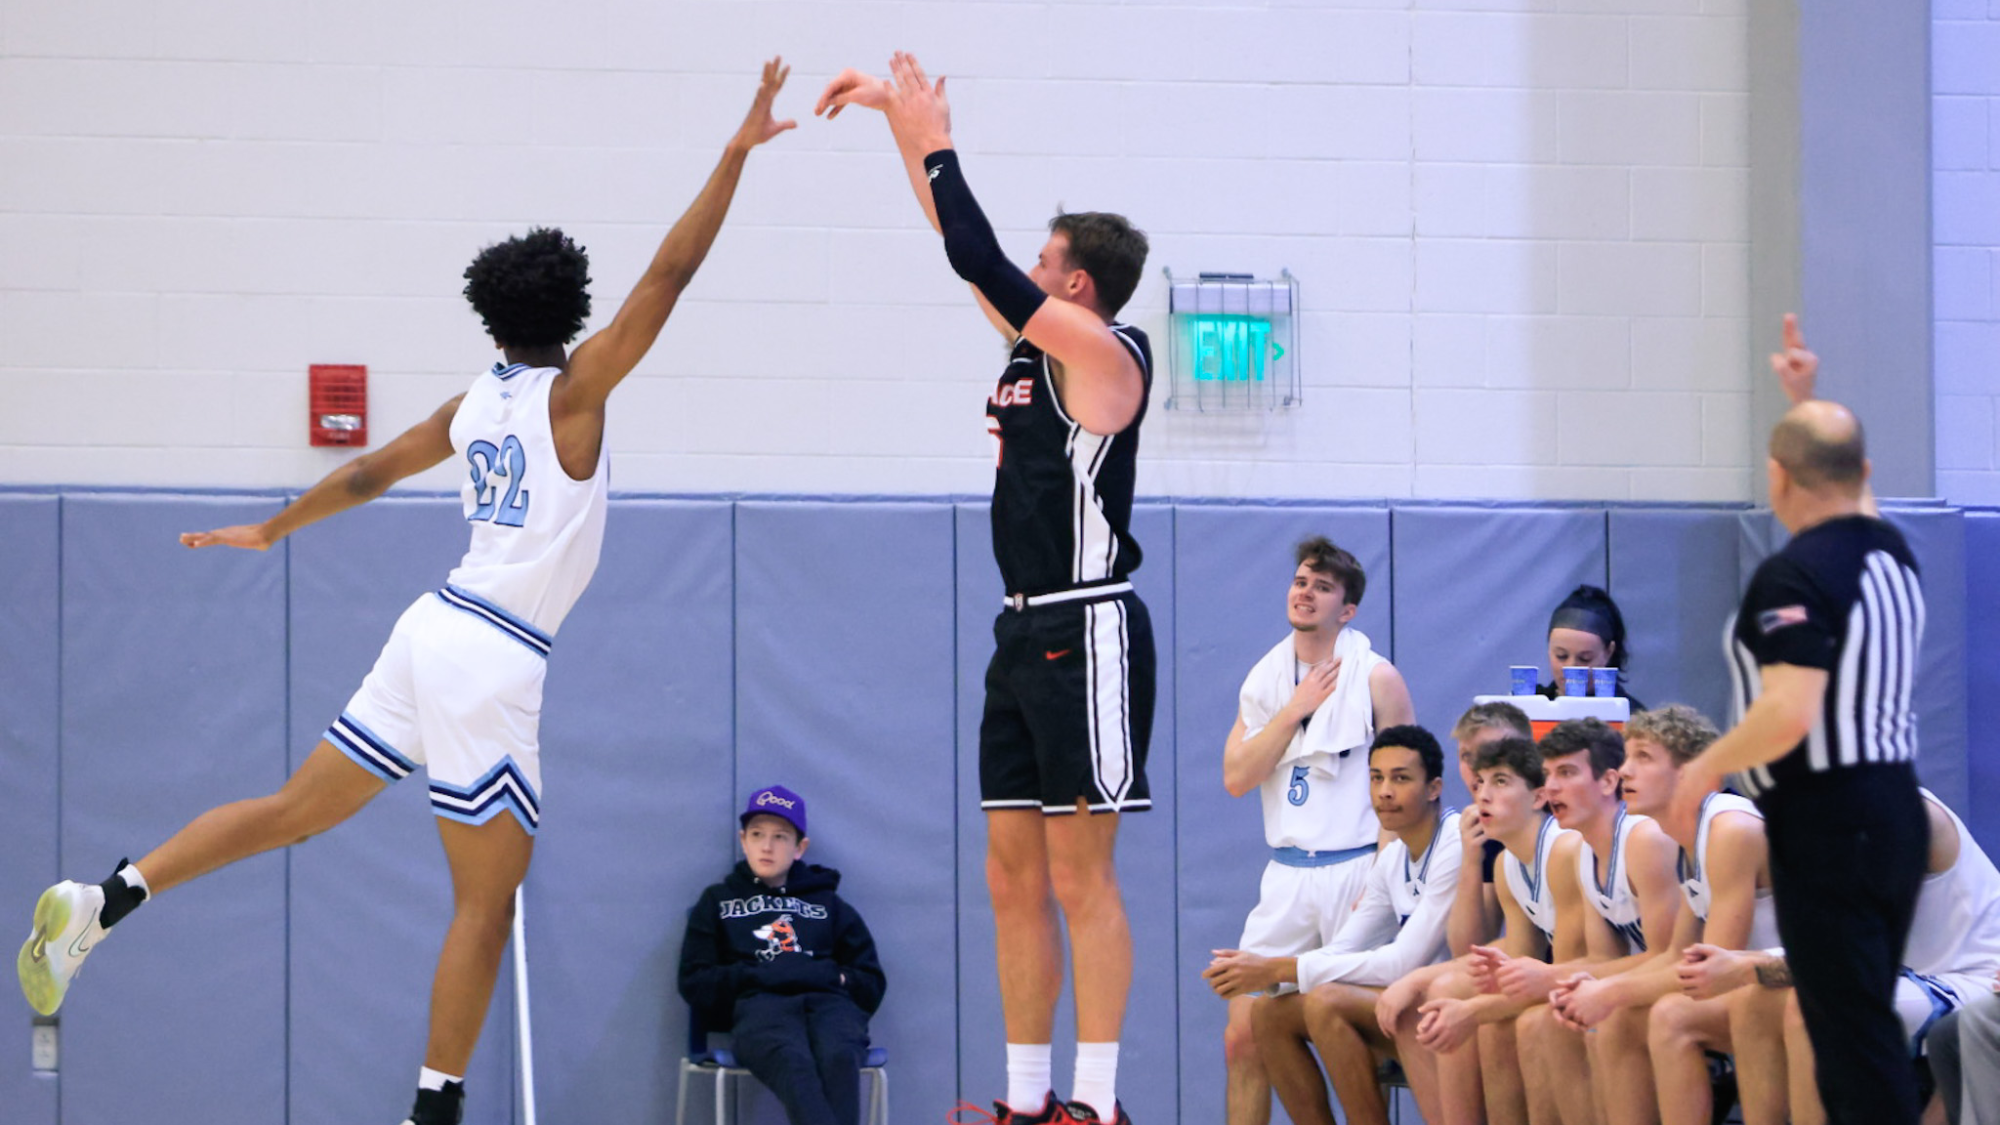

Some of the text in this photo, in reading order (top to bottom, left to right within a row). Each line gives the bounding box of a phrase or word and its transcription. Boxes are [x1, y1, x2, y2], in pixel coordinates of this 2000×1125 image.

[1194, 320, 1270, 381] EXIT
[467, 434, 529, 528] 22
[1288, 765, 1310, 807] 5
[720, 894, 828, 919] JACKETS
